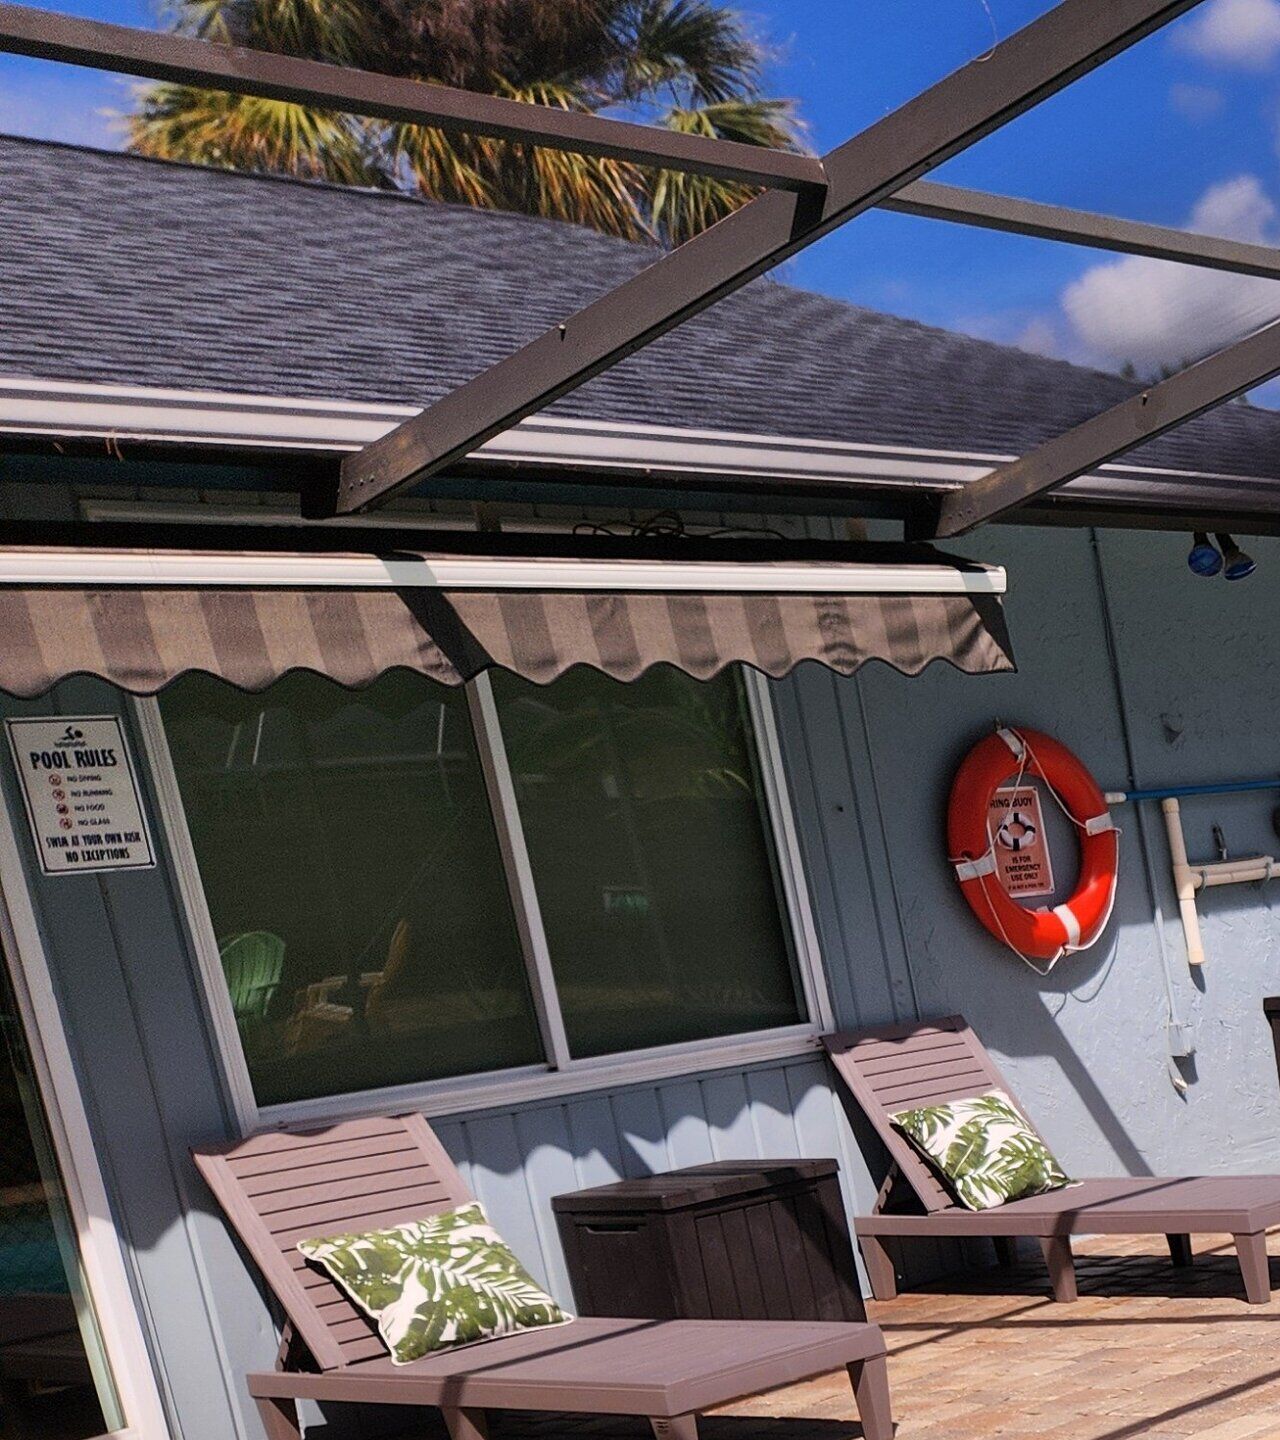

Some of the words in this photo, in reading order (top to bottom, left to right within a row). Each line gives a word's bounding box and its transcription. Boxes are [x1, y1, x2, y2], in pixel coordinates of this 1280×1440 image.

[30, 750, 71, 770] POOL
[74, 748, 118, 768] RULES
[78, 774, 102, 782] DIVING
[1012, 797, 1033, 807] BUOY
[86, 803, 105, 811] FOOD
[89, 818, 111, 826] GLASS
[45, 836, 69, 848] SWIM
[71, 835, 80, 847] AT
[82, 834, 103, 846] YOUR
[104, 832, 123, 844] OWN
[123, 831, 141, 843] RISK
[65, 850, 79, 862] NO
[81, 847, 130, 862] EXCEPTIONS
[1019, 855, 1031, 863] FOR
[1005, 864, 1041, 874] EMERGENCY
[1011, 873, 1023, 881] USE
[1024, 872, 1038, 880] ONLY
